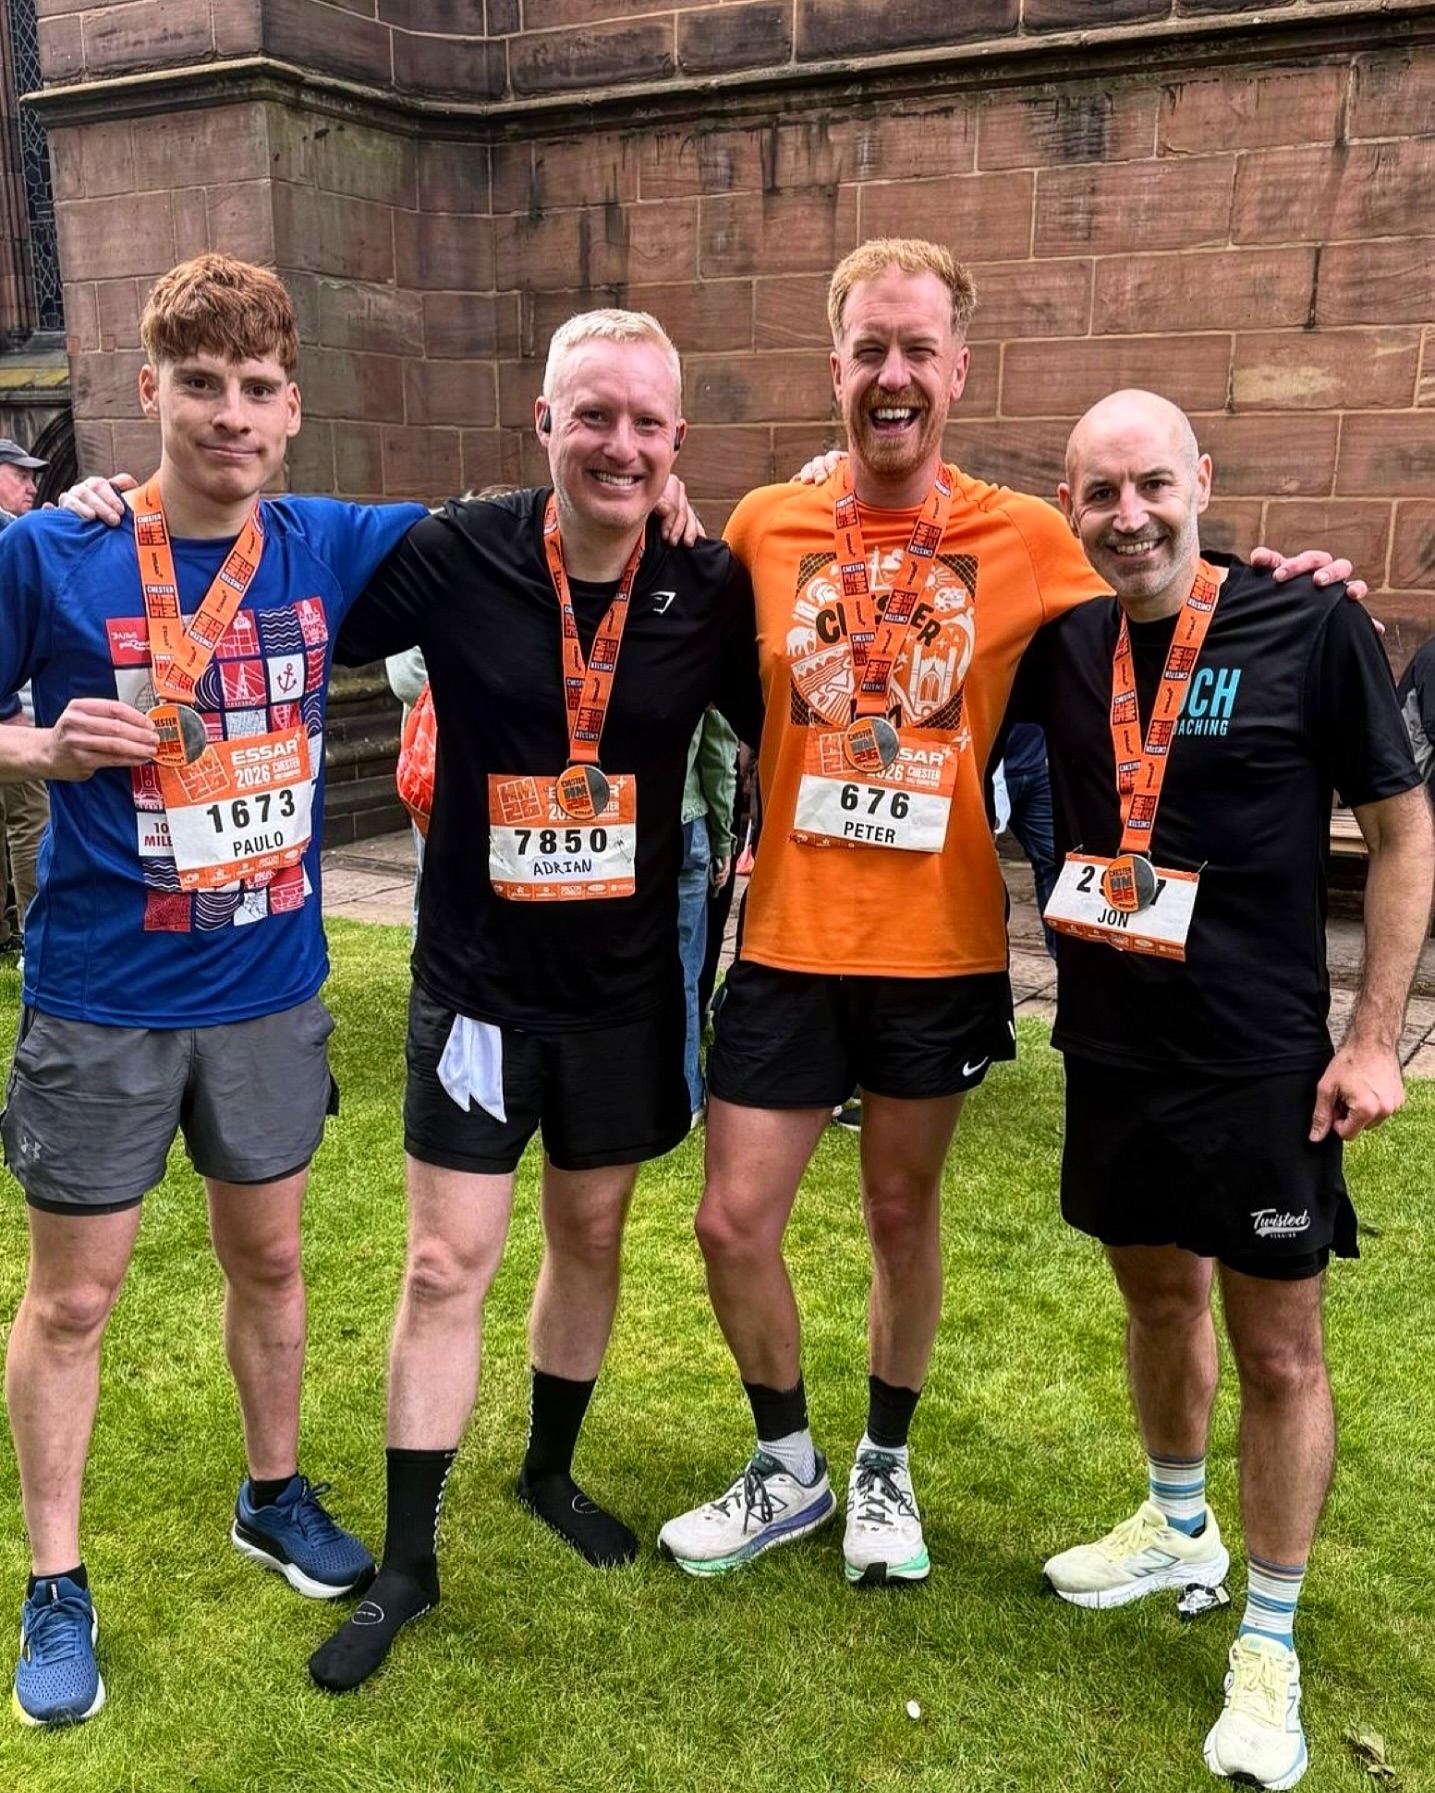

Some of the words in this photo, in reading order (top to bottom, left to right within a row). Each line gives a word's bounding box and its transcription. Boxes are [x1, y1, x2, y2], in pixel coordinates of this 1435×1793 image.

[1184, 668, 1242, 718] CH
[849, 728, 872, 741] CHESTER
[231, 740, 299, 766] ESSAR
[854, 748, 879, 763] 26
[898, 747, 944, 766] SAR
[234, 762, 271, 789] 2026
[908, 766, 940, 780] CHESTER
[206, 789, 295, 833] 1673
[840, 784, 910, 820] 676
[154, 822, 169, 834] 10
[844, 821, 896, 844] PETER
[233, 830, 284, 858] PAULO
[514, 828, 607, 855] 7850
[533, 859, 592, 876] ADRIAN
[1109, 866, 1132, 877] CHESTER
[1076, 865, 1166, 906] 27
[1097, 908, 1131, 928] JON
[1250, 1208, 1310, 1230] Twisted
